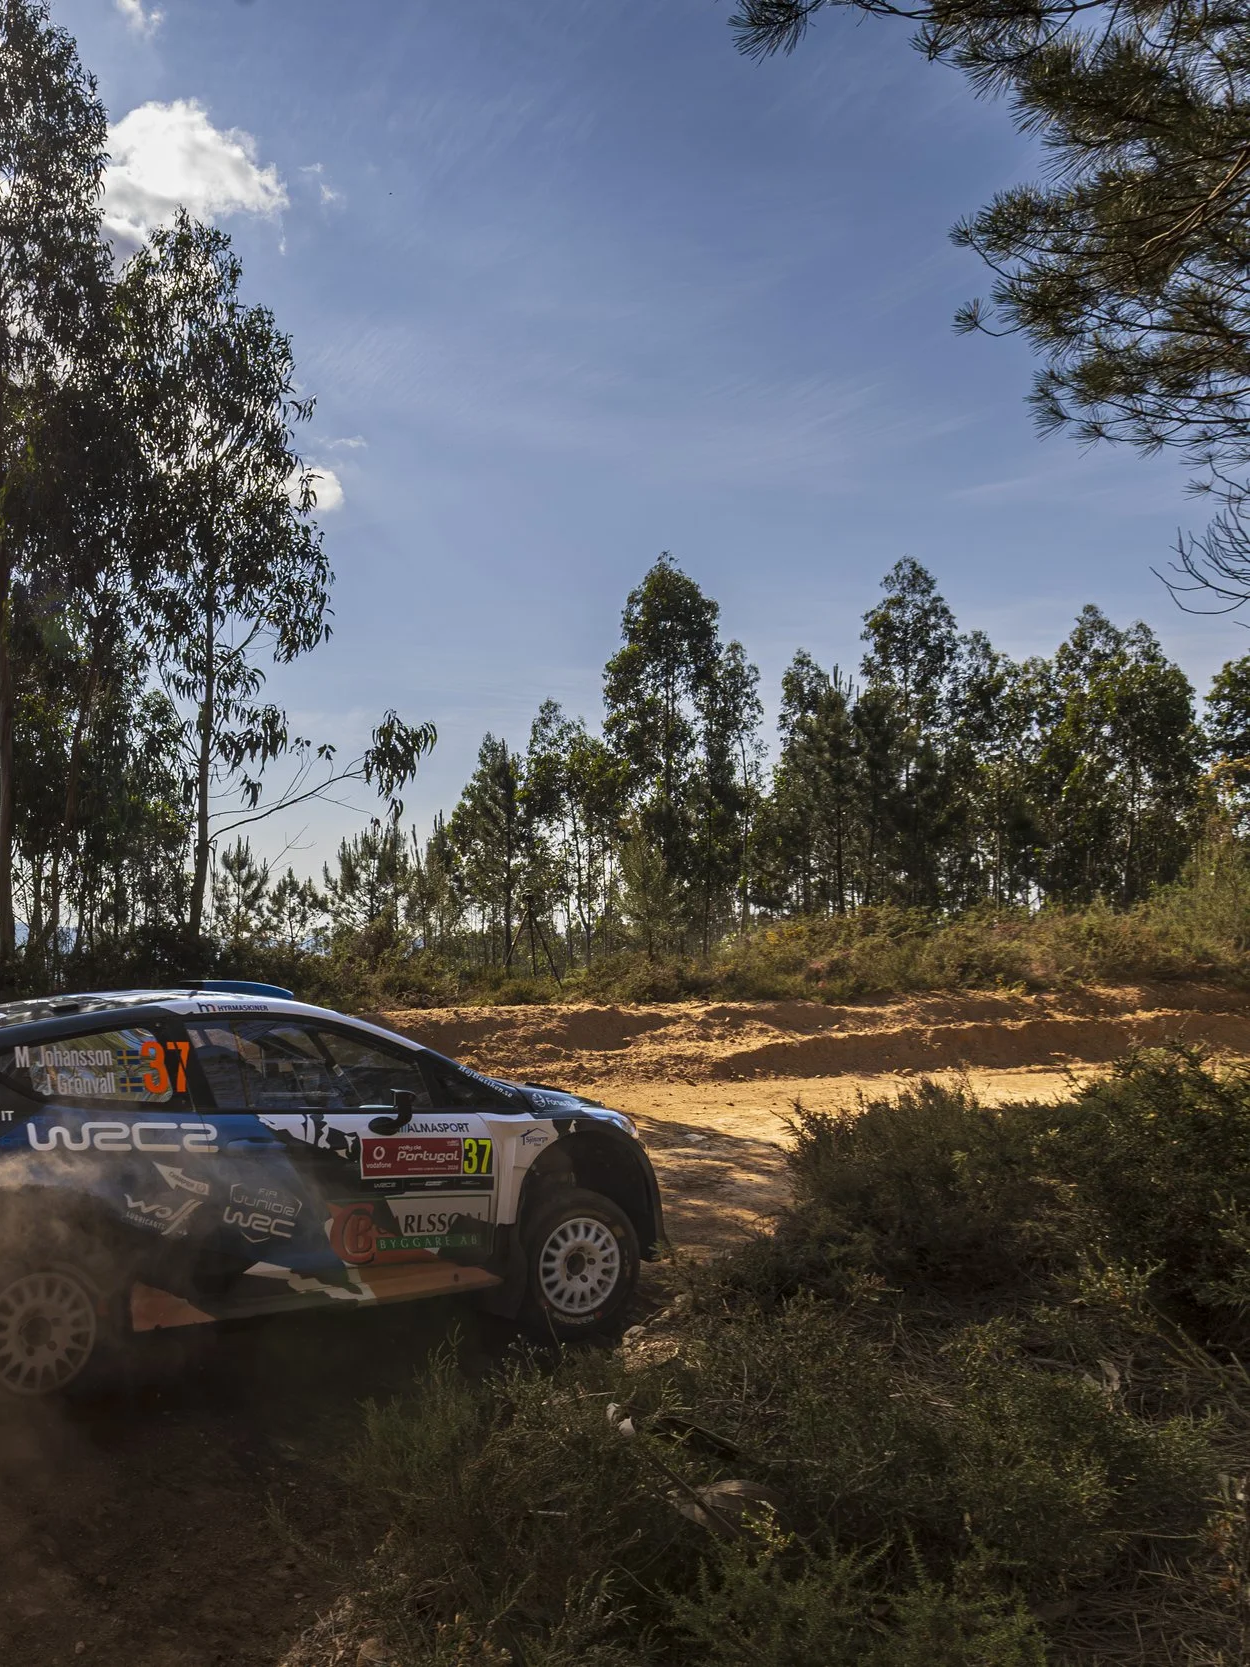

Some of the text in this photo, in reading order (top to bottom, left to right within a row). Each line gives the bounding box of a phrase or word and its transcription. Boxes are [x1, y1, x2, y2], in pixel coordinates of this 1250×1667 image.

[14, 1045, 113, 1068] M Johansson
[141, 1041, 190, 1094] 37
[43, 1072, 116, 1096] J Grönvall
[1, 1110, 15, 1121] IT
[27, 1121, 219, 1152] WRC2
[397, 1150, 459, 1163] Portugal
[463, 1138, 491, 1174] 37
[258, 1187, 278, 1198] FIA
[233, 1194, 295, 1217] JUNIOR
[223, 1206, 296, 1238] WRC
[380, 1234, 479, 1249] BYGGARE AB
